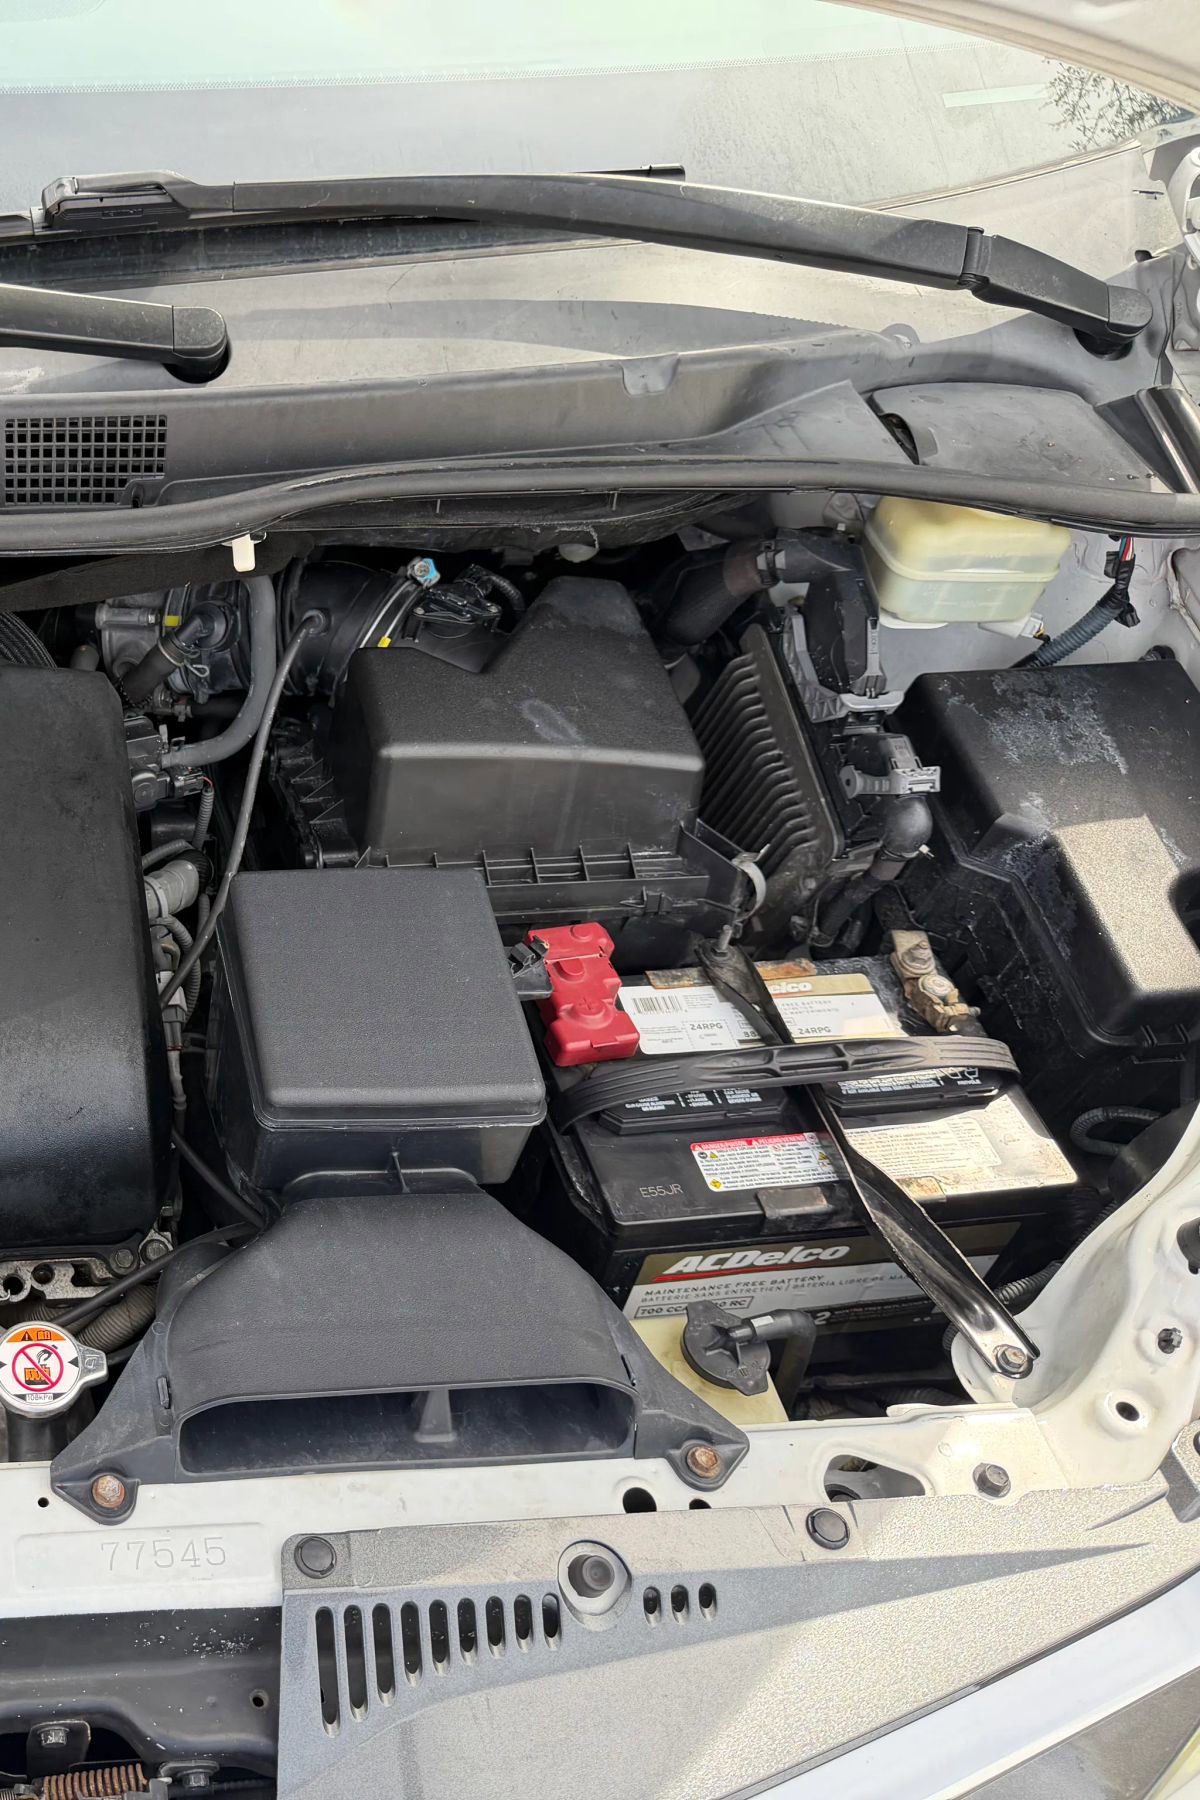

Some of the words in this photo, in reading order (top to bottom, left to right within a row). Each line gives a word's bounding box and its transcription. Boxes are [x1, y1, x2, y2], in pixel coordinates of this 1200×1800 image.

[639, 1183, 684, 1198] E55JR
[662, 1245, 851, 1275] ACDelco
[644, 1282, 731, 1297] MAINTENANCE
[735, 1279, 767, 1288] FREE
[770, 1275, 825, 1286] BATTERY
[641, 1307, 664, 1316] 700
[730, 1299, 746, 1307] RC
[101, 1536, 226, 1571] 77545
